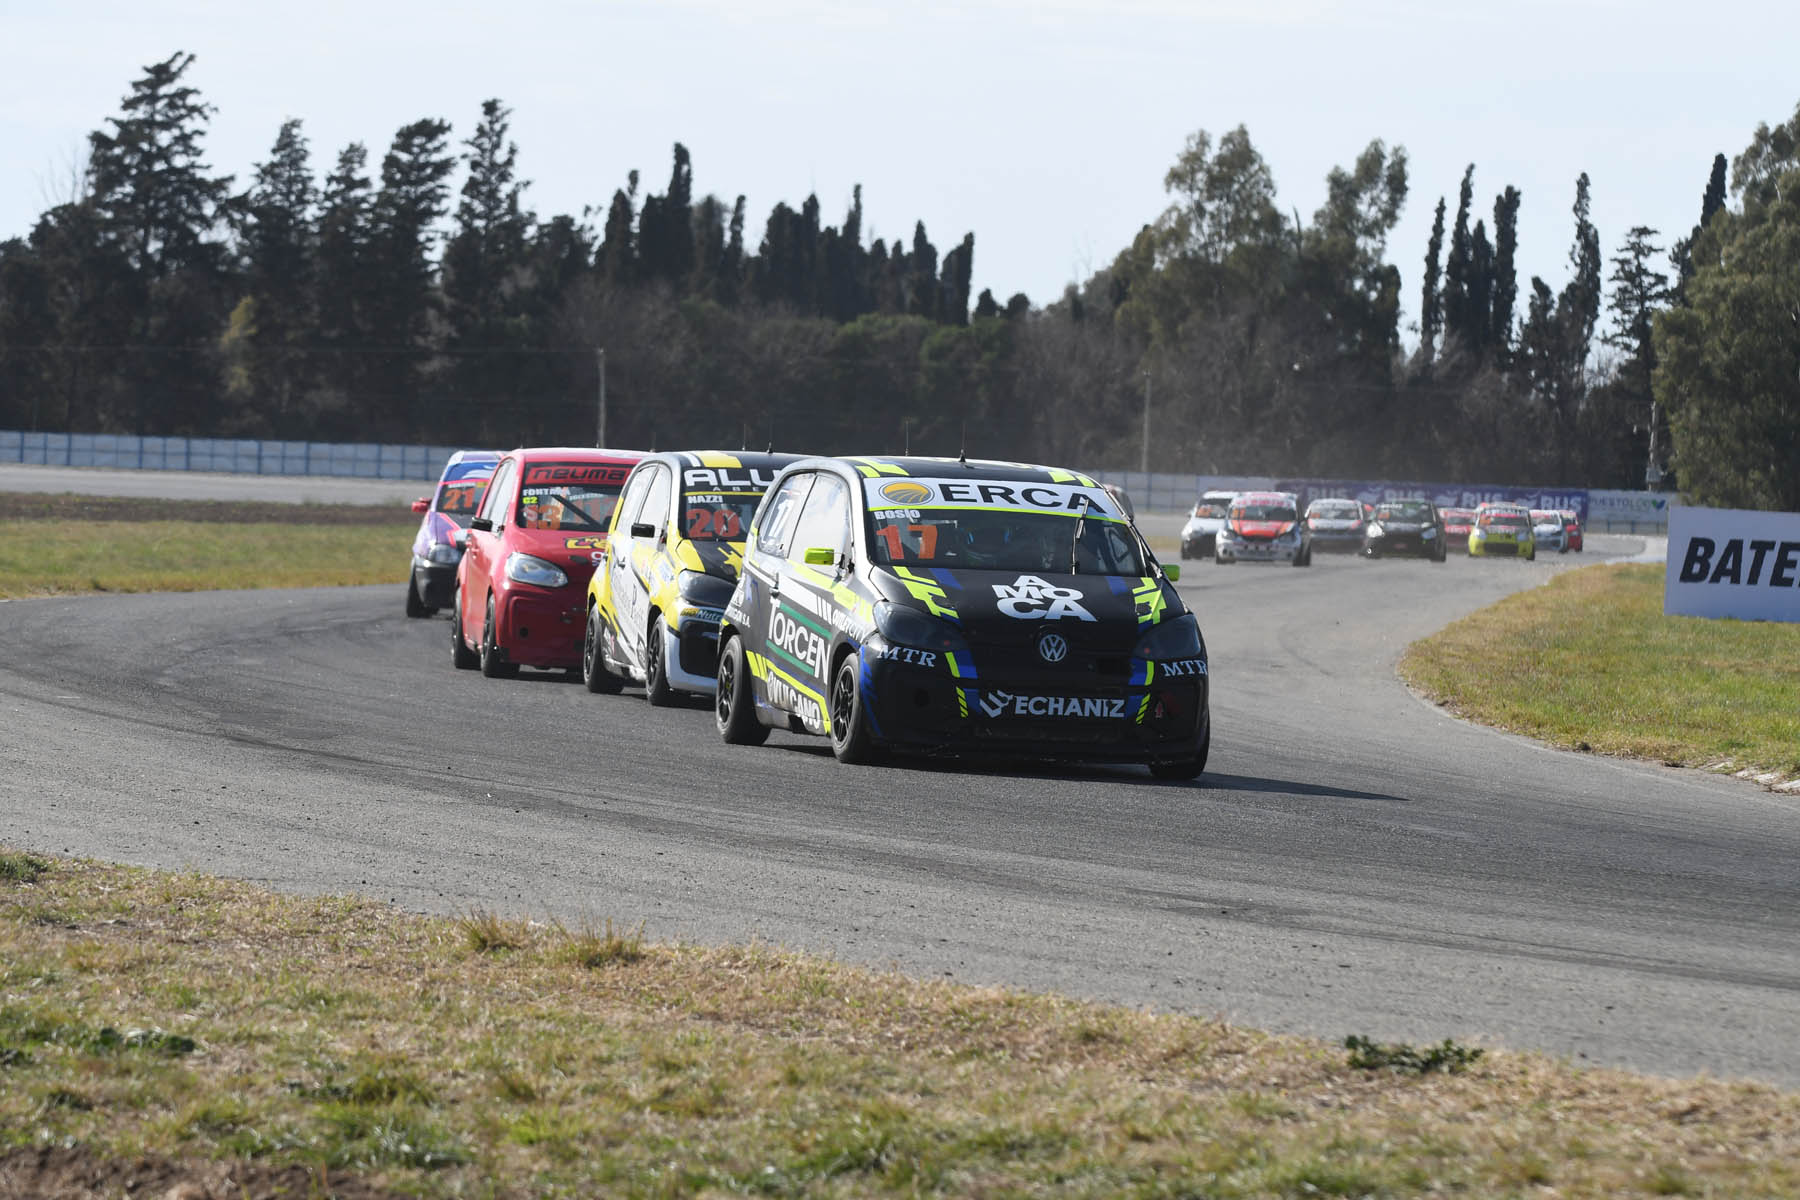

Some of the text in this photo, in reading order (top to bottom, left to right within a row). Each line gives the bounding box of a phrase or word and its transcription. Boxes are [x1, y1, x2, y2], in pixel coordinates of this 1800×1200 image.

[443, 487, 475, 510] 21
[938, 483, 1107, 514] ERCA
[1541, 495, 1582, 512] RUS
[686, 508, 740, 538] 20
[873, 509, 921, 521] BOSIO
[877, 525, 939, 560] 17
[1679, 536, 1800, 587] BATE
[1013, 575, 1050, 588] A
[768, 596, 832, 686] TORCEN
[878, 645, 937, 668] MTR
[1160, 659, 1208, 678] MTR
